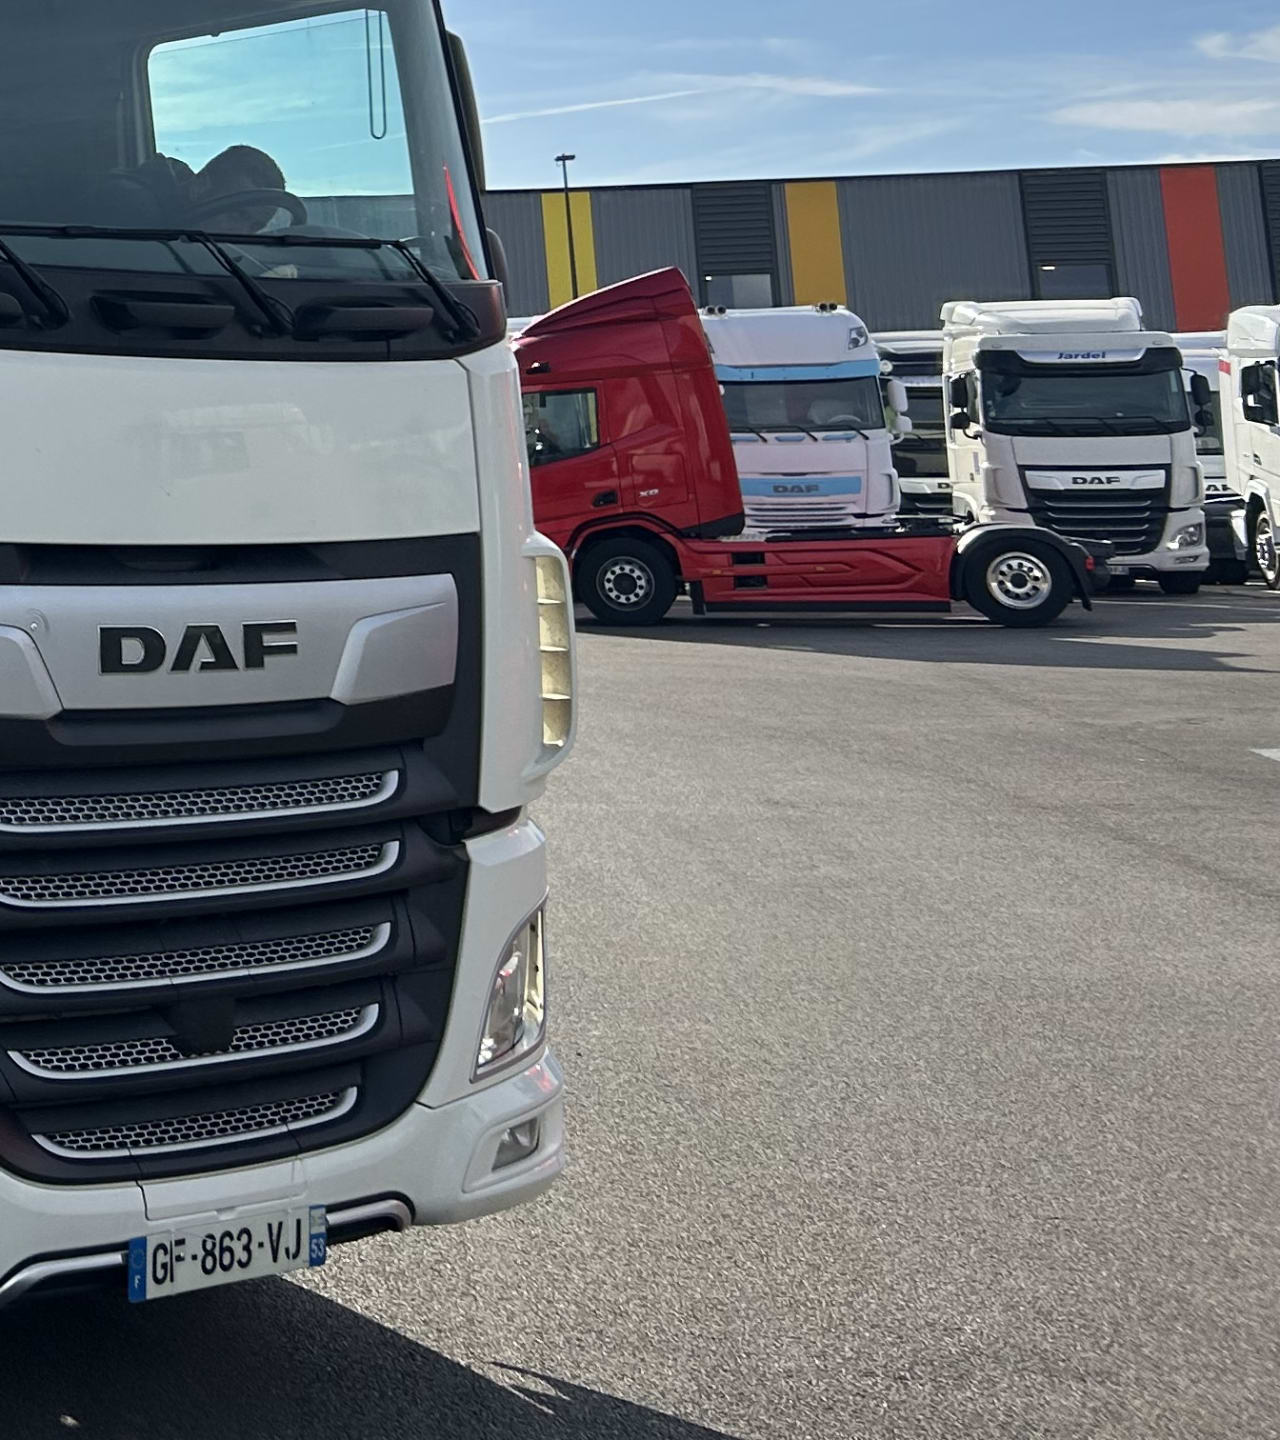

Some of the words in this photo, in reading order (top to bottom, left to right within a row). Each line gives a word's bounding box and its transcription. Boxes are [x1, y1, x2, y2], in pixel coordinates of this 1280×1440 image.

[772, 484, 819, 494] DAF
[1071, 476, 1121, 486] DAF
[98, 619, 298, 675] DAF
[151, 1218, 302, 1285] GF-863-VJ
[311, 1237, 325, 1259] 53
